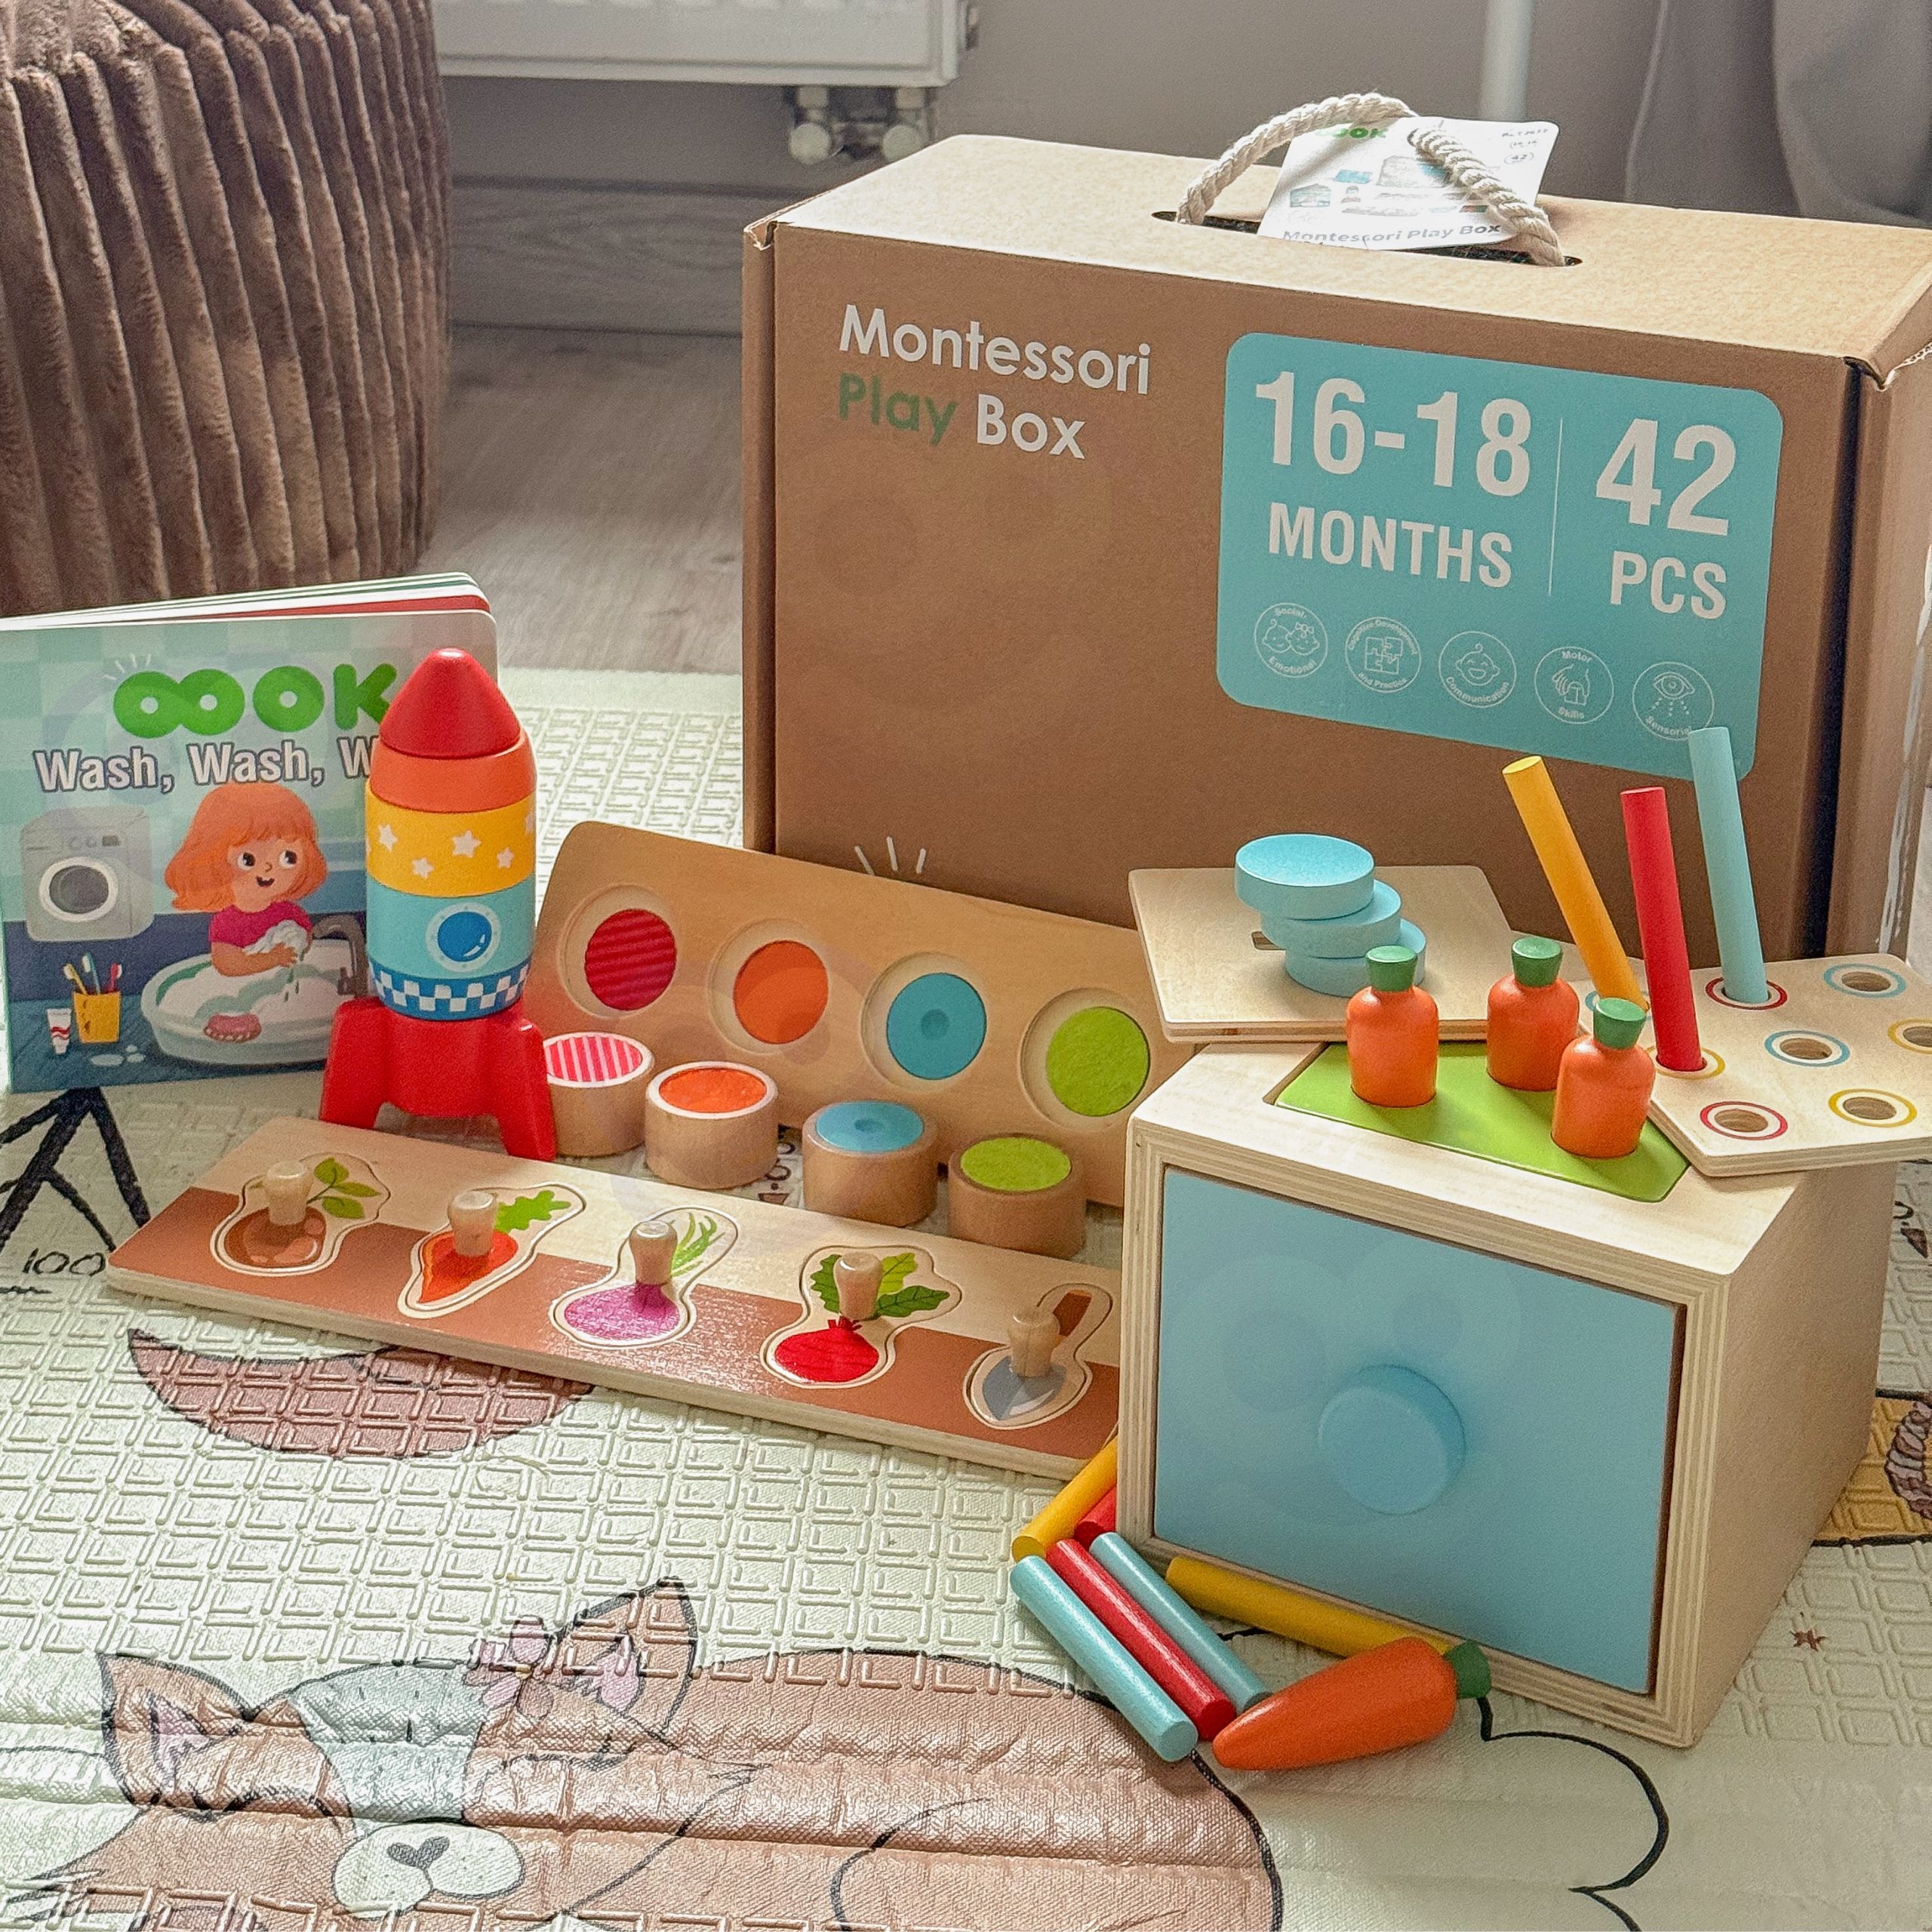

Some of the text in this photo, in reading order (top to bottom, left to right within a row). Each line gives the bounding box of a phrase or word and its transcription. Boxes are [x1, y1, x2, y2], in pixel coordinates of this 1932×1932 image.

[1407, 228, 1454, 239] Play
[1460, 224, 1503, 235] Box
[839, 304, 1152, 395] Montessori
[838, 372, 1086, 460] Play Box
[1255, 371, 1532, 498] 16-18
[1595, 417, 1737, 537] 42
[1268, 501, 1512, 589] MONTHS
[1609, 549, 1727, 621] PCS
[1268, 655, 1318, 675] Emotional
[1561, 651, 1594, 664] Motor
[1445, 676, 1510, 703] Communication
[1557, 706, 1586, 720] Skills
[33, 746, 175, 794] Wash,
[186, 740, 326, 788] Wash,
[22, 1247, 106, 1277] 100
